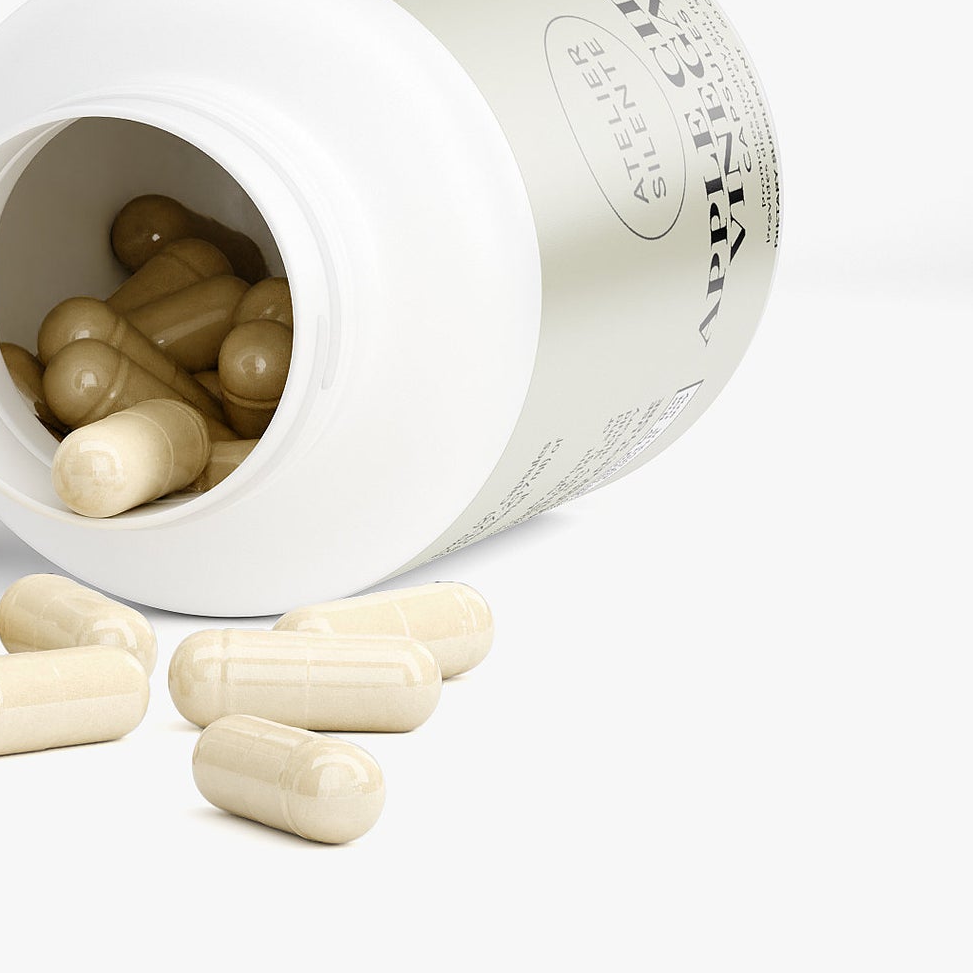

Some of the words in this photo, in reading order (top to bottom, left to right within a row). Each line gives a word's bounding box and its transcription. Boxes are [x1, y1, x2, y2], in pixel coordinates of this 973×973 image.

[567, 44, 649, 204] ATELIER
[583, 37, 667, 199] SILENTE
[677, 8, 752, 173] CAPSULES
[684, 107, 729, 347] APPLE
